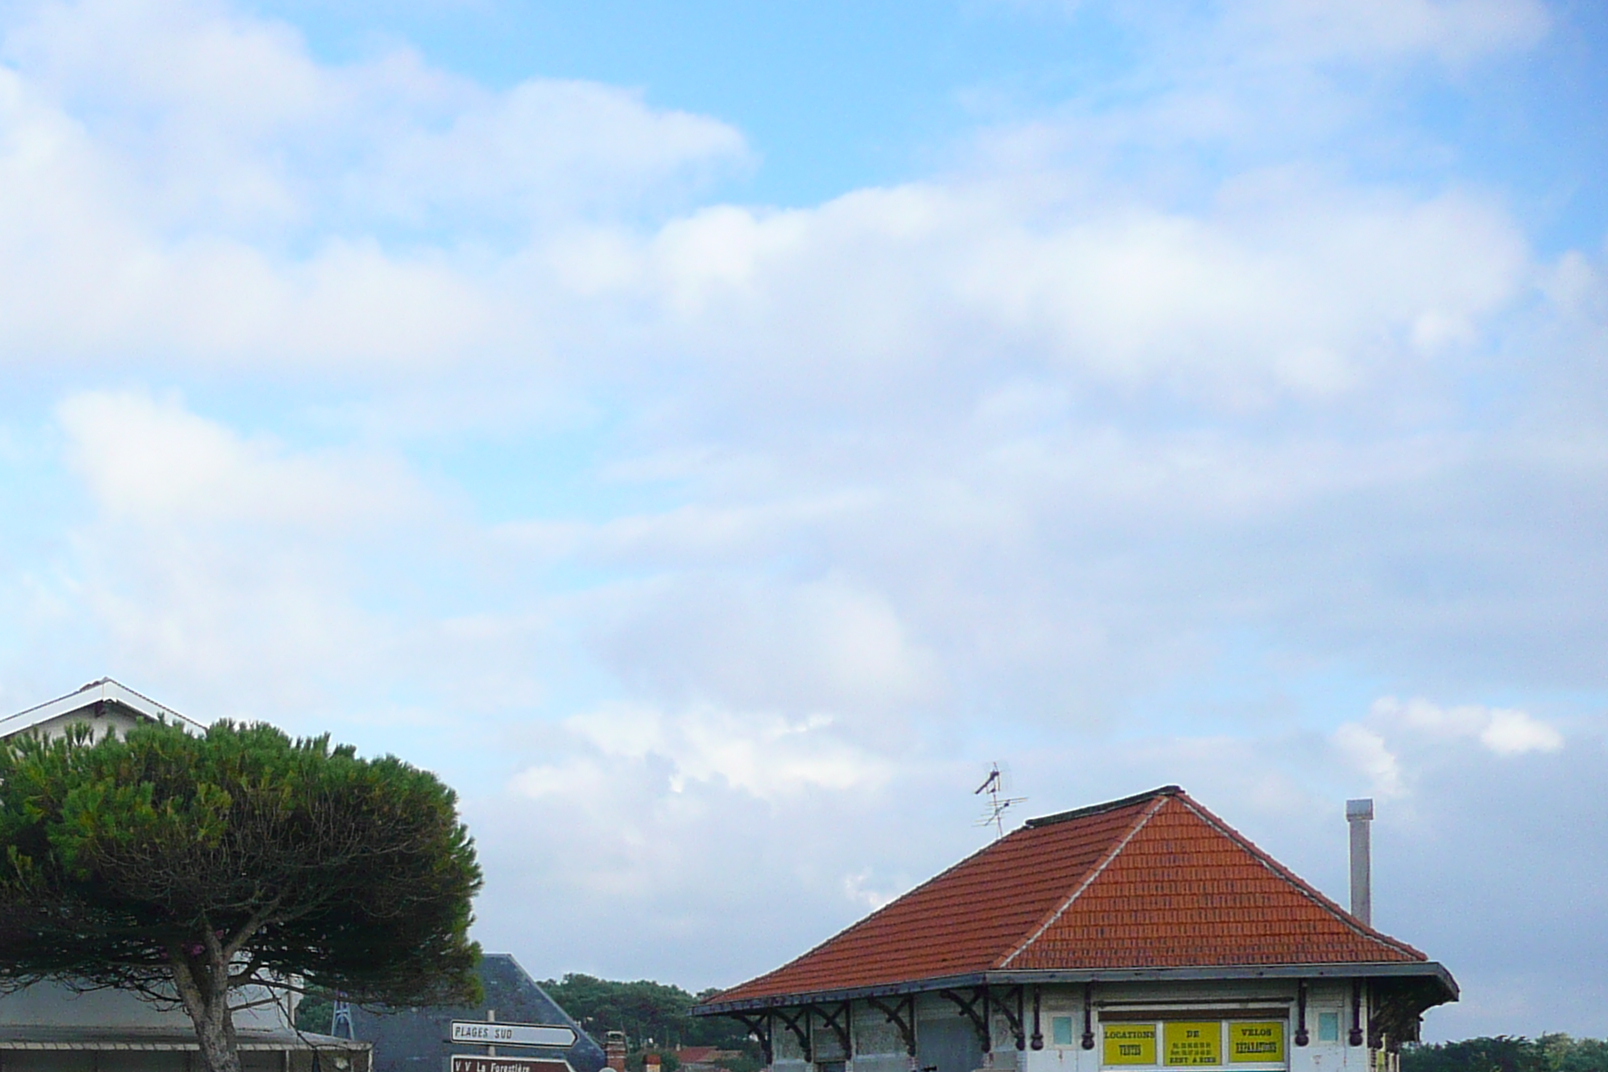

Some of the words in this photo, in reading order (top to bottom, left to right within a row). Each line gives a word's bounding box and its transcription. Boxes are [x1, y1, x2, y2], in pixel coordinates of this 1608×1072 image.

[454, 1026, 489, 1038] PLAGES
[494, 1029, 512, 1040] SUD
[1104, 1031, 1155, 1039] LOCATIONS
[1186, 1030, 1199, 1038] DE
[455, 1061, 461, 1072] V
[465, 1061, 472, 1072] V
[476, 1062, 486, 1072] La
